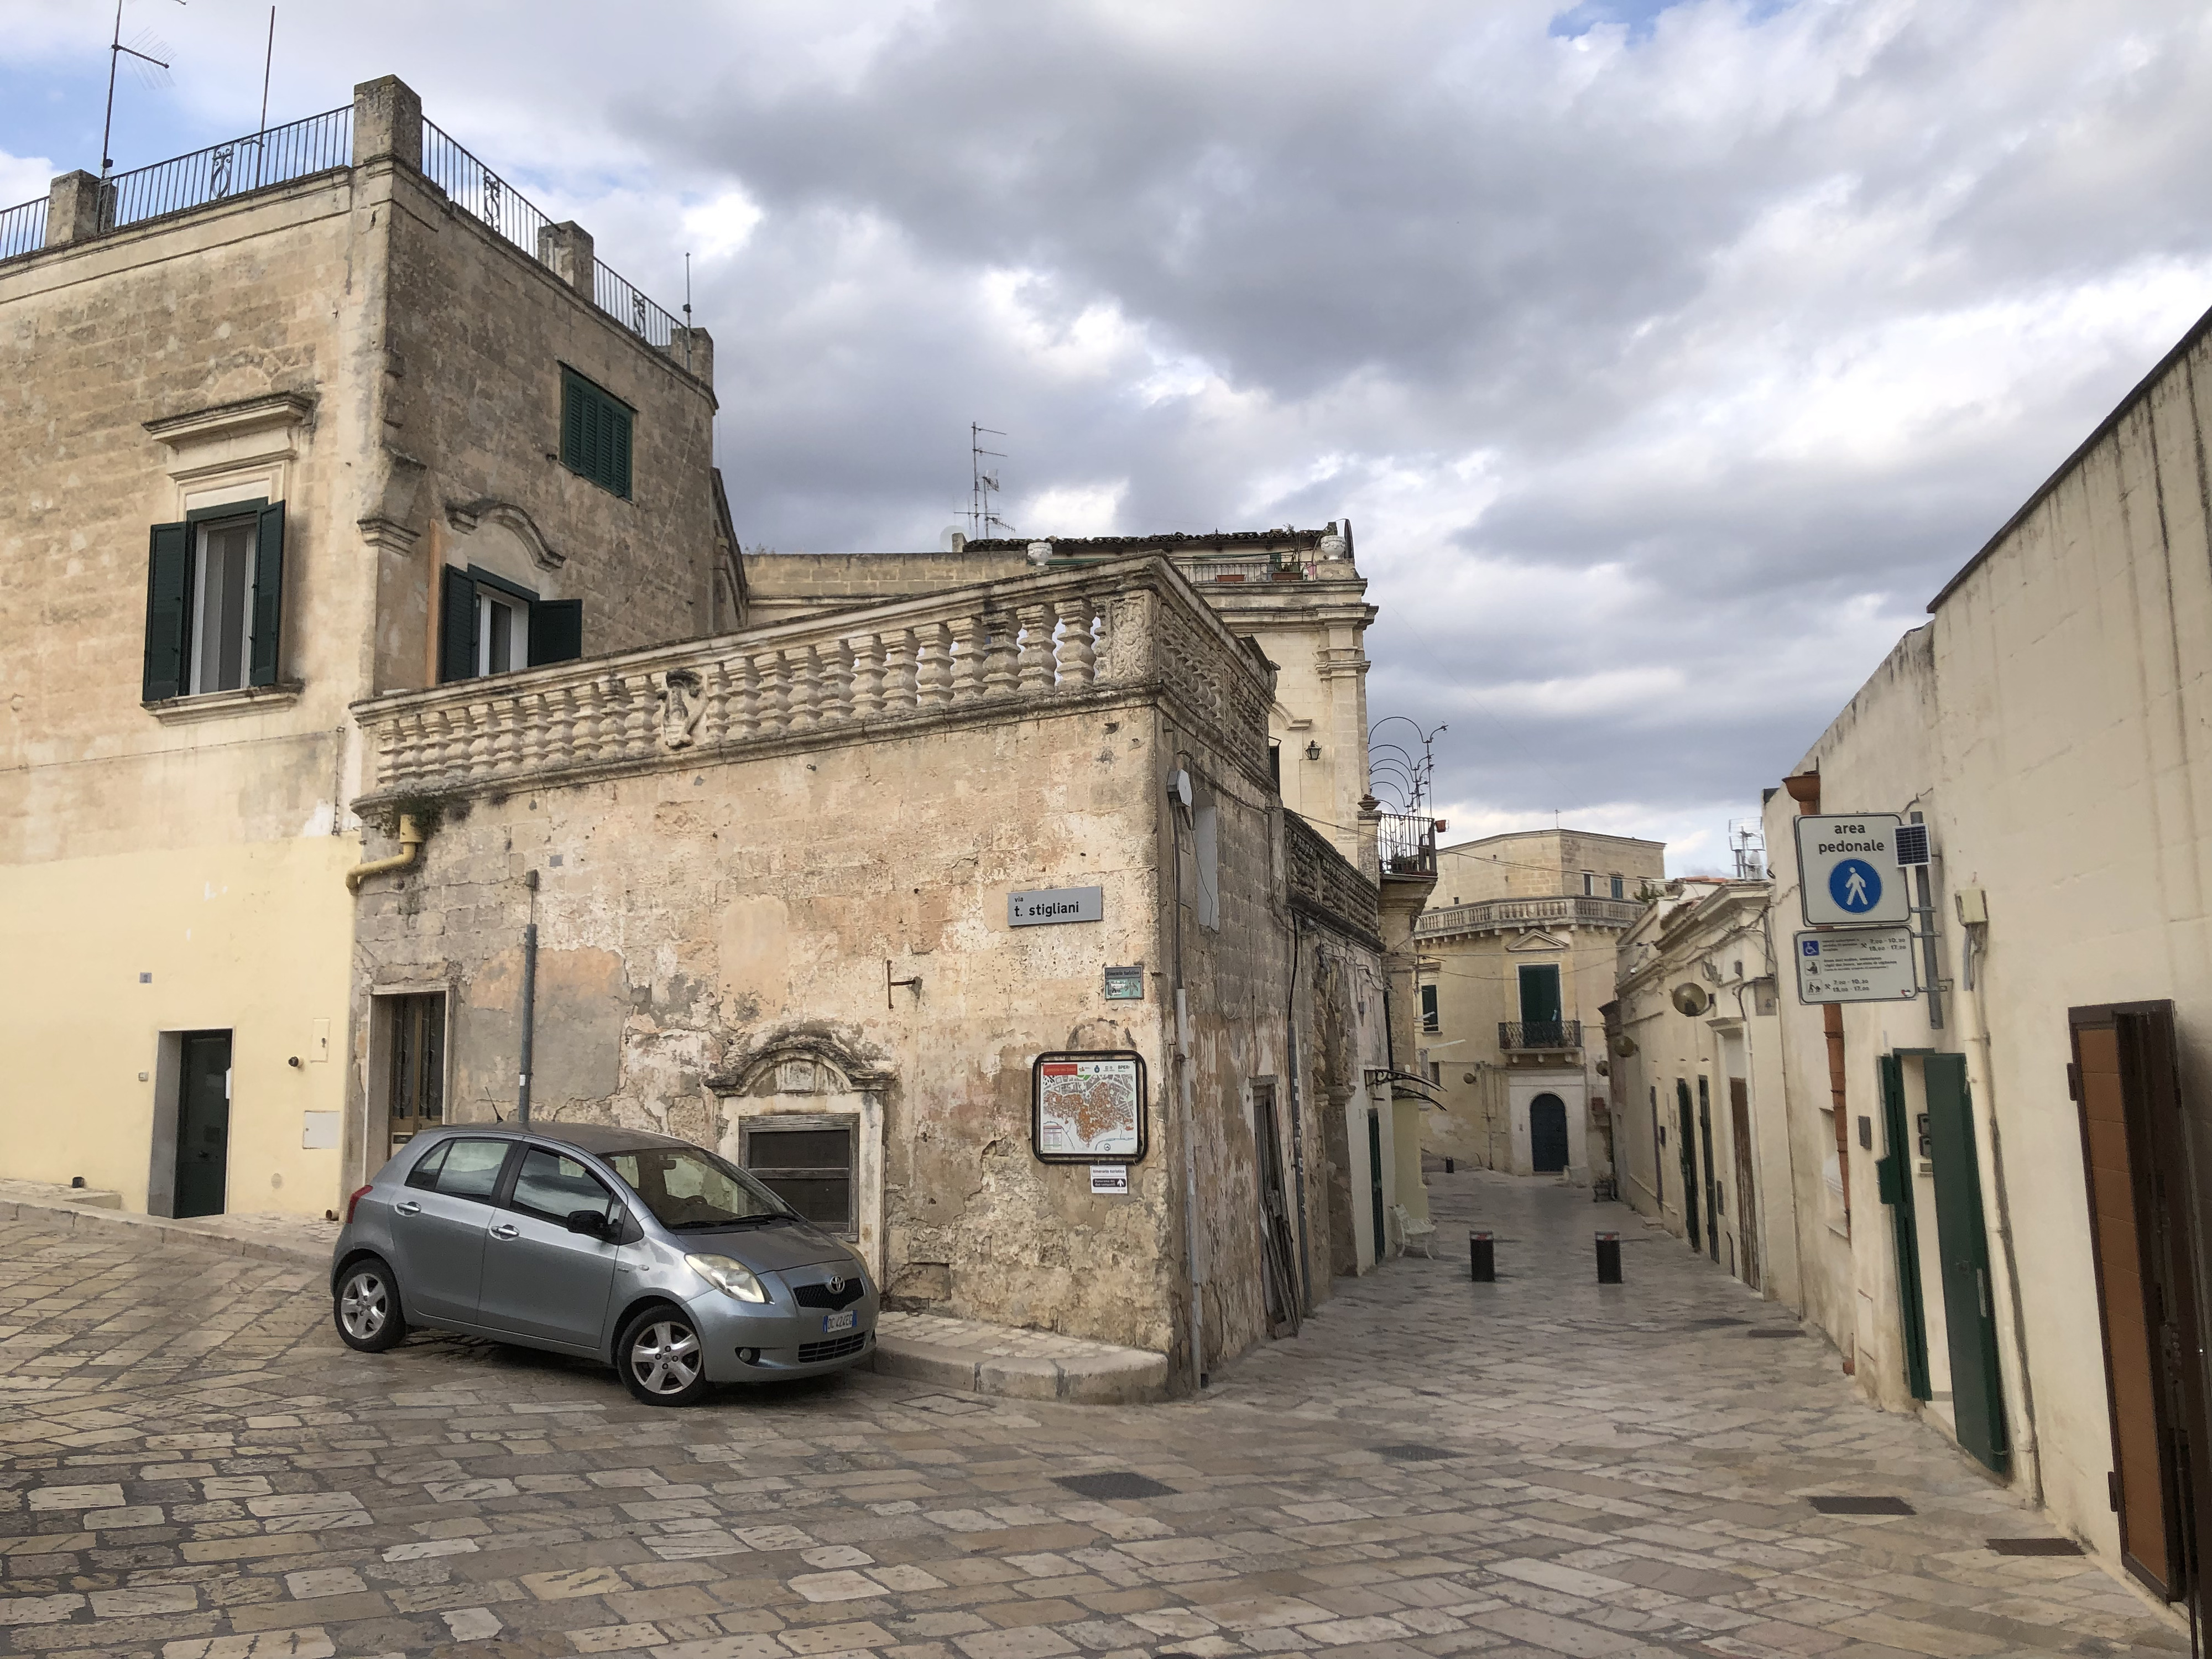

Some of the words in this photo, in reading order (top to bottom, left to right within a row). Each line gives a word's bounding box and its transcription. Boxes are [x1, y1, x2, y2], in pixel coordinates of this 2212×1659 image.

[1834, 825, 1865, 834] area
[1818, 839, 1885, 855] pedonale
[1014, 905, 1023, 917] t.
[1029, 901, 1079, 917] stigliani
